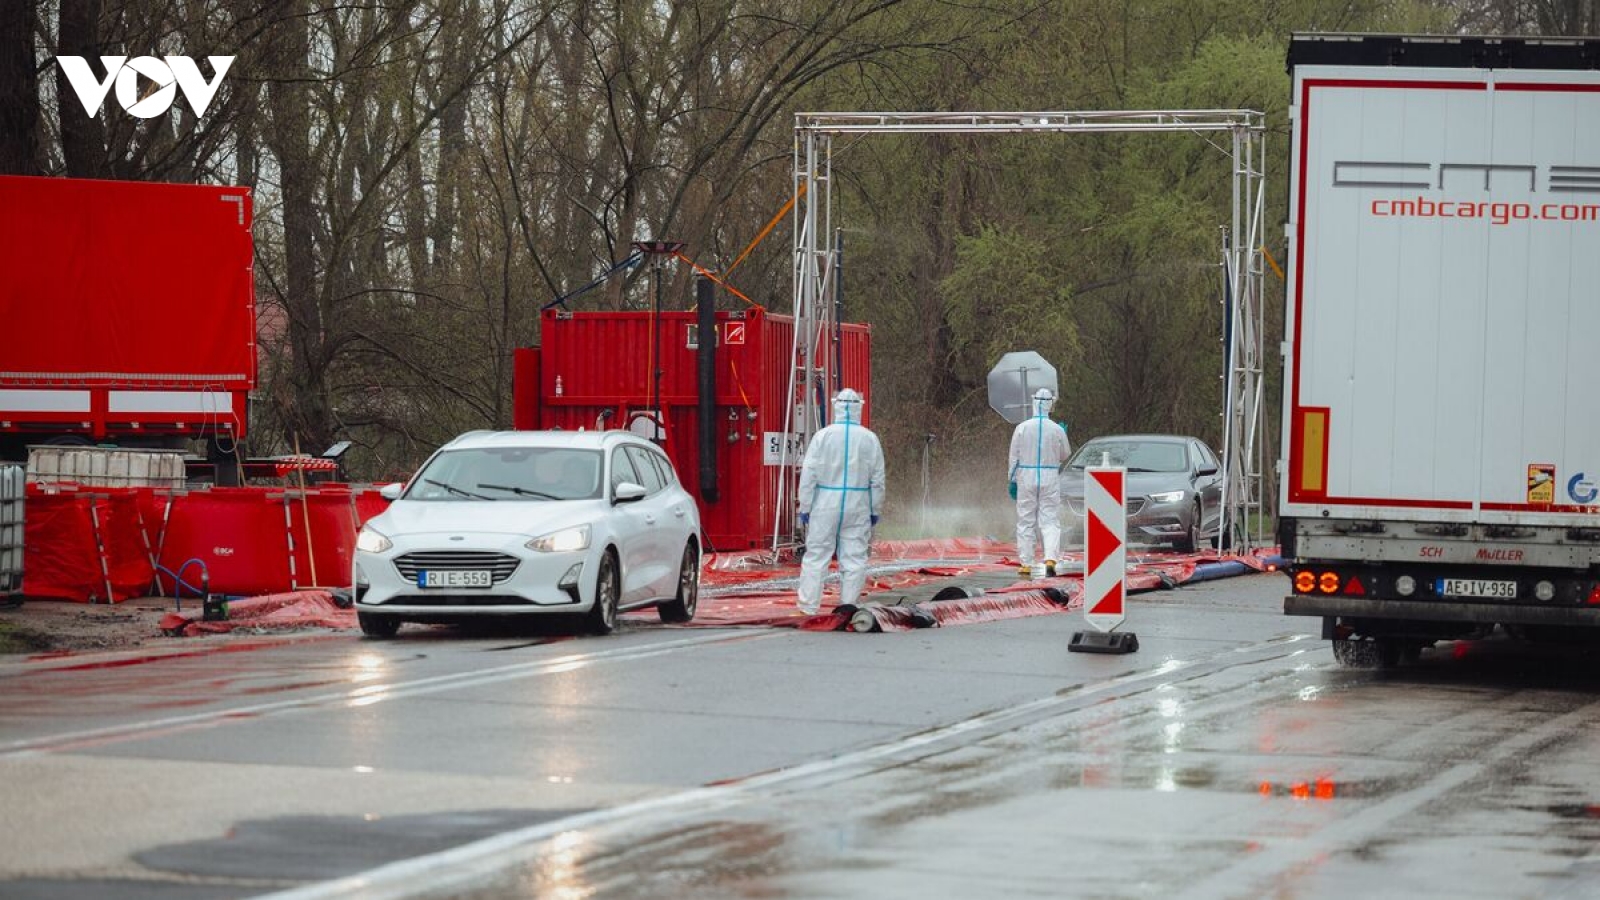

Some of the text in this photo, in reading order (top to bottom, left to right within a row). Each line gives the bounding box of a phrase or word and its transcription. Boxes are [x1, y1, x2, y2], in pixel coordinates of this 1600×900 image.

[1371, 196, 1600, 225] cmbcargo.com
[1419, 546, 1443, 557] SCH
[427, 571, 488, 585] RIE-559
